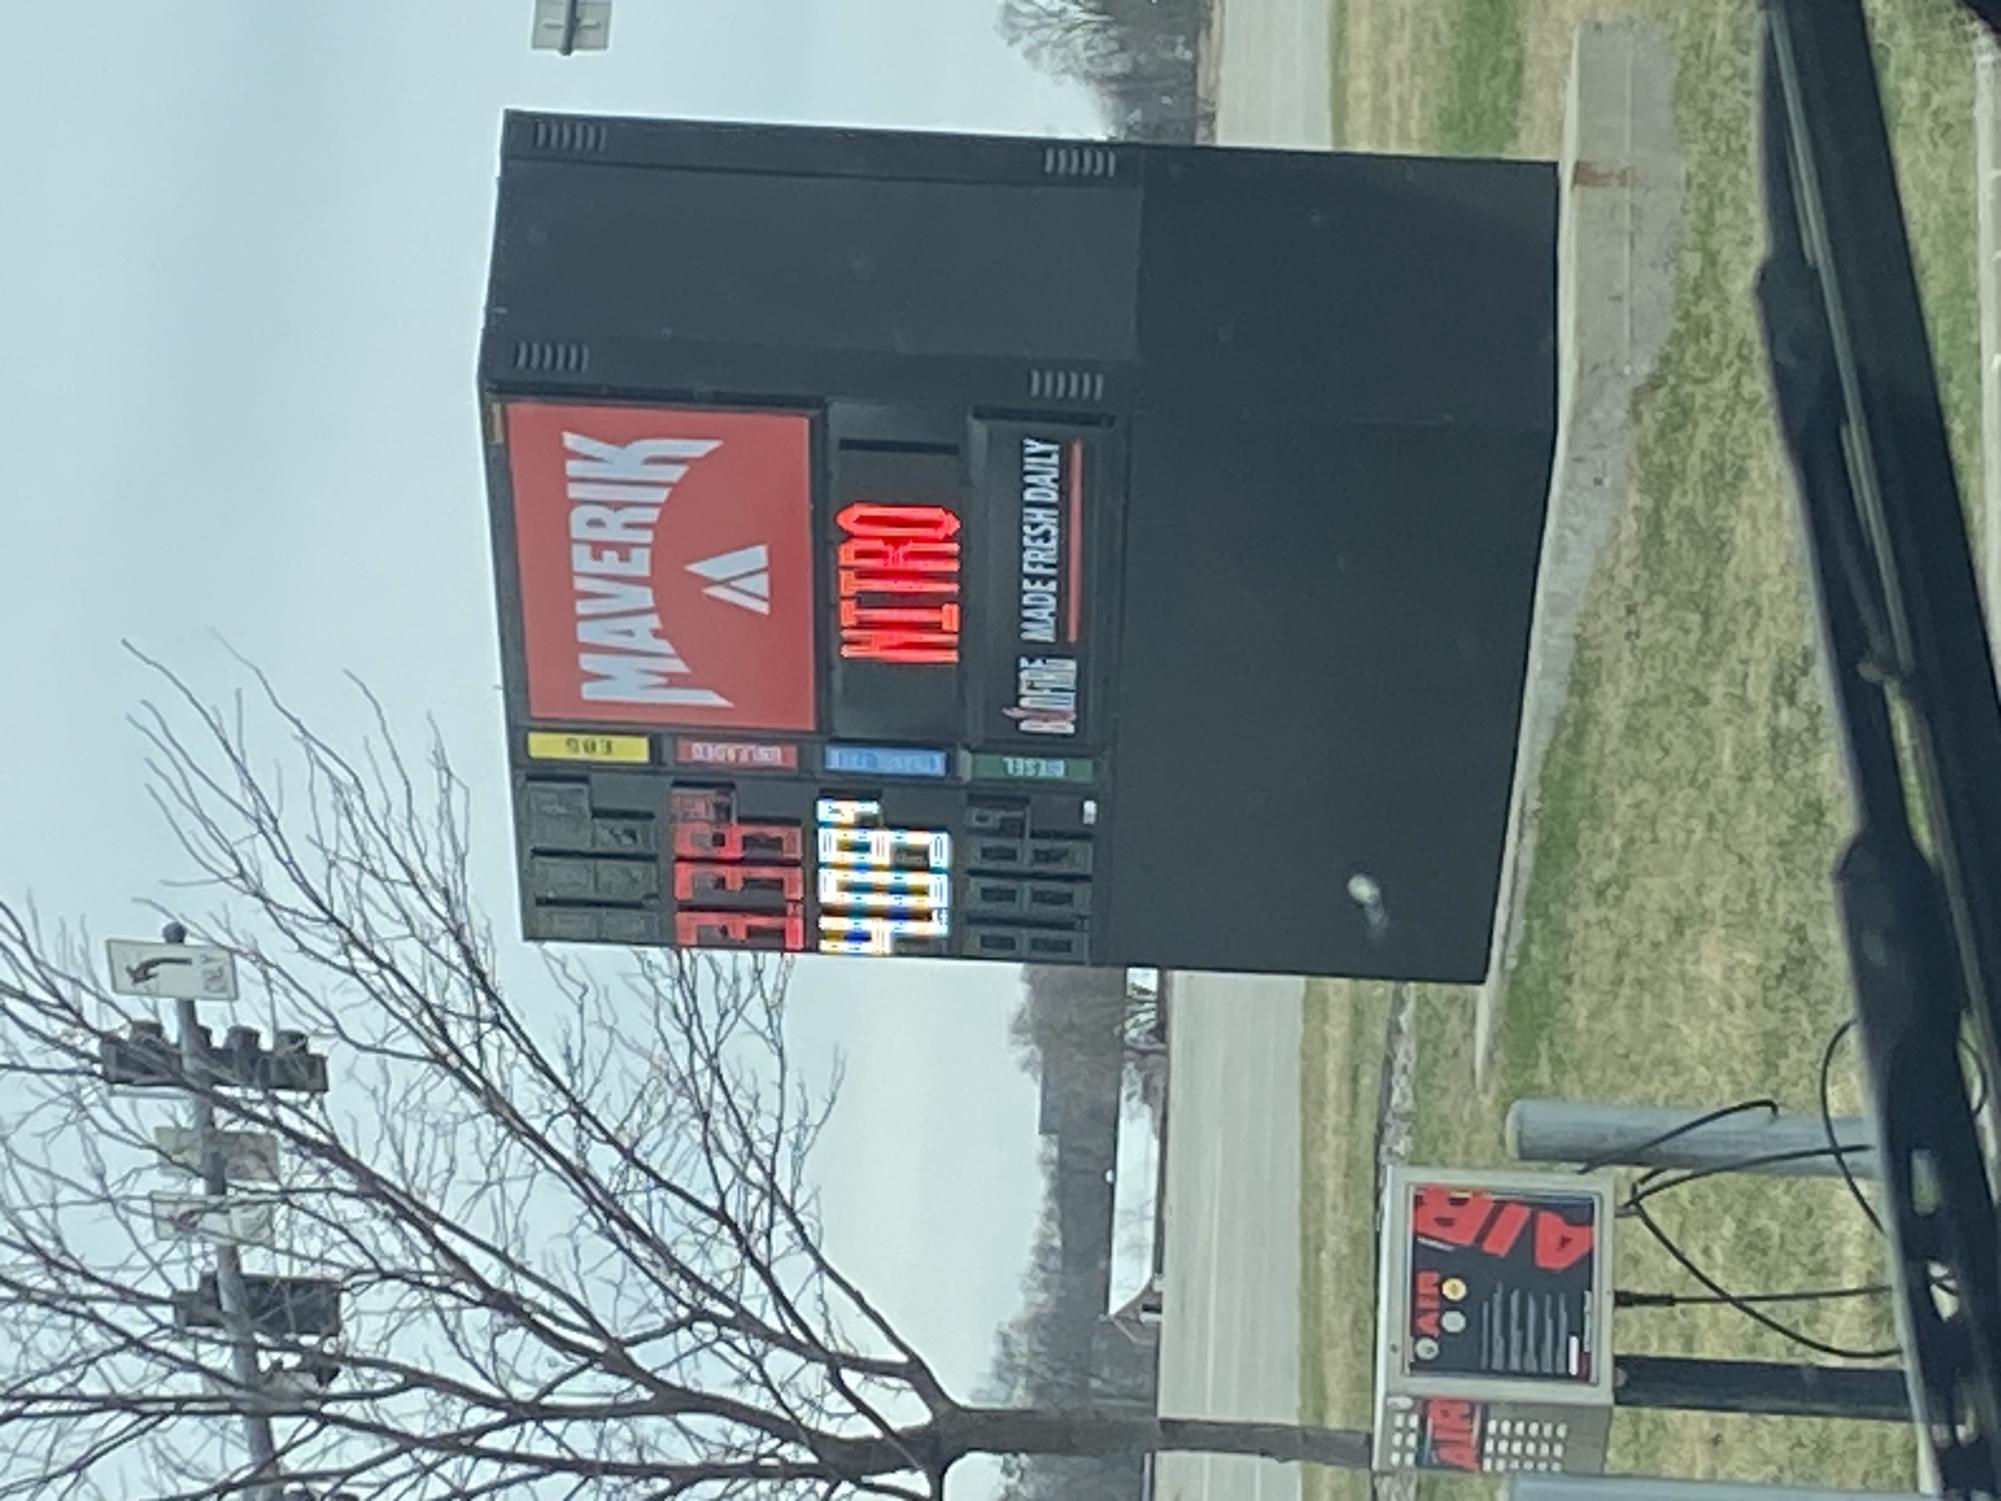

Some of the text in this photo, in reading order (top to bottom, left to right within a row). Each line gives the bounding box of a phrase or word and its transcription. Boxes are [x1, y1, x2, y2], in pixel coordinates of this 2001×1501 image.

[561, 430, 735, 708] MAVERIK
[836, 502, 961, 663] NITRO
[1020, 436, 1061, 643] MADE FRESH DAILY
[1003, 756, 1066, 778] DIESEL
[1416, 1269, 1441, 1337] AIR
[1427, 1400, 1481, 1470] AIR
